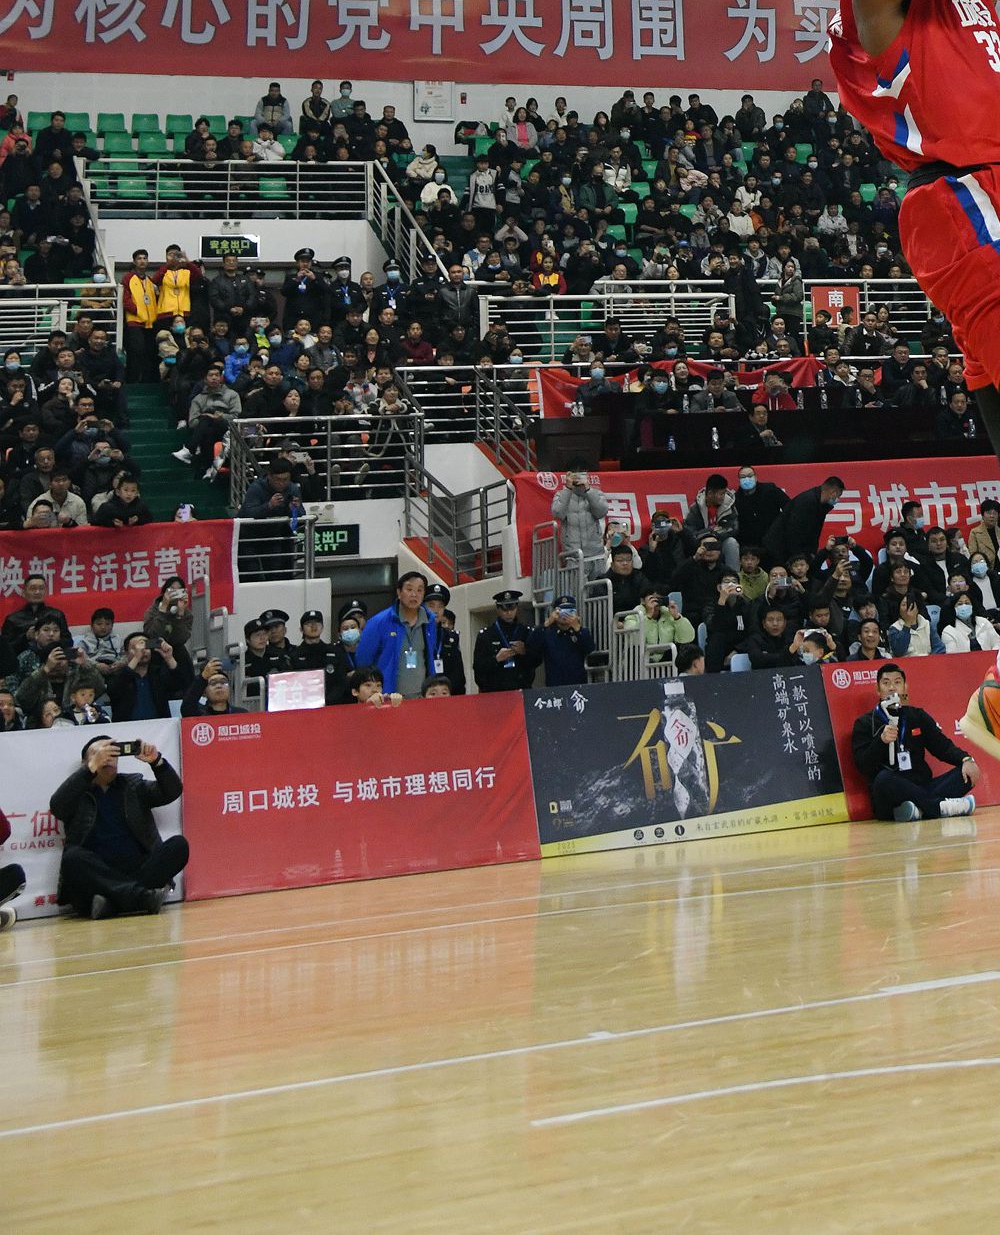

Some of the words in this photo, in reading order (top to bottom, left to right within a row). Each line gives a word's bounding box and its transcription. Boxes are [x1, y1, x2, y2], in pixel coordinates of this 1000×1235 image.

[210, 240, 250, 249] 安全出口
[772, 673, 799, 754] 高端矿泉水
[789, 674, 821, 781] 一款可以喷脸的
[218, 723, 261, 737] 周口城投
[222, 784, 320, 815] 周口城投
[332, 766, 497, 804] 与城市理想同行
[11, 839, 56, 851] GUANG
